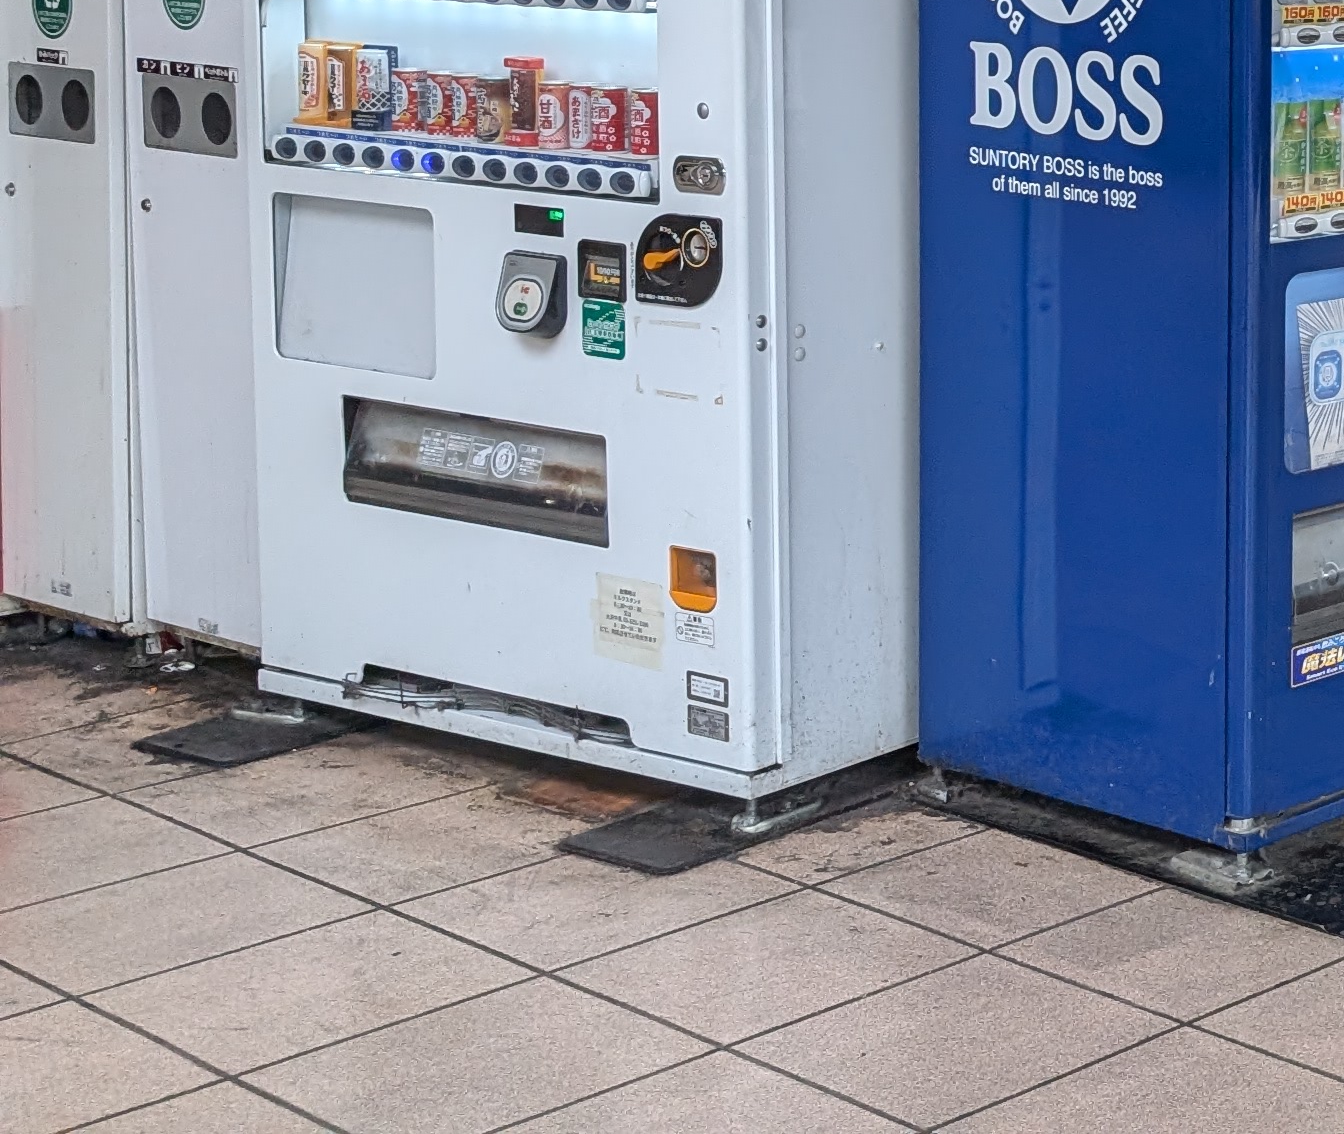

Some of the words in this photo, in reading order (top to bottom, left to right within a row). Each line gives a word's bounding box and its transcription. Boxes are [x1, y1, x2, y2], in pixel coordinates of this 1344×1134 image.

[969, 40, 1163, 147] BOSS
[969, 146, 1040, 172] SUNTORY
[1043, 152, 1084, 178] BOSS
[1088, 158, 1100, 180] is
[1102, 161, 1126, 184] the
[1129, 164, 1163, 188] boss
[991, 174, 1006, 193] of
[1008, 176, 1042, 196] them
[1044, 180, 1060, 200] all
[1062, 181, 1098, 204] since
[1102, 186, 1137, 209] 1992
